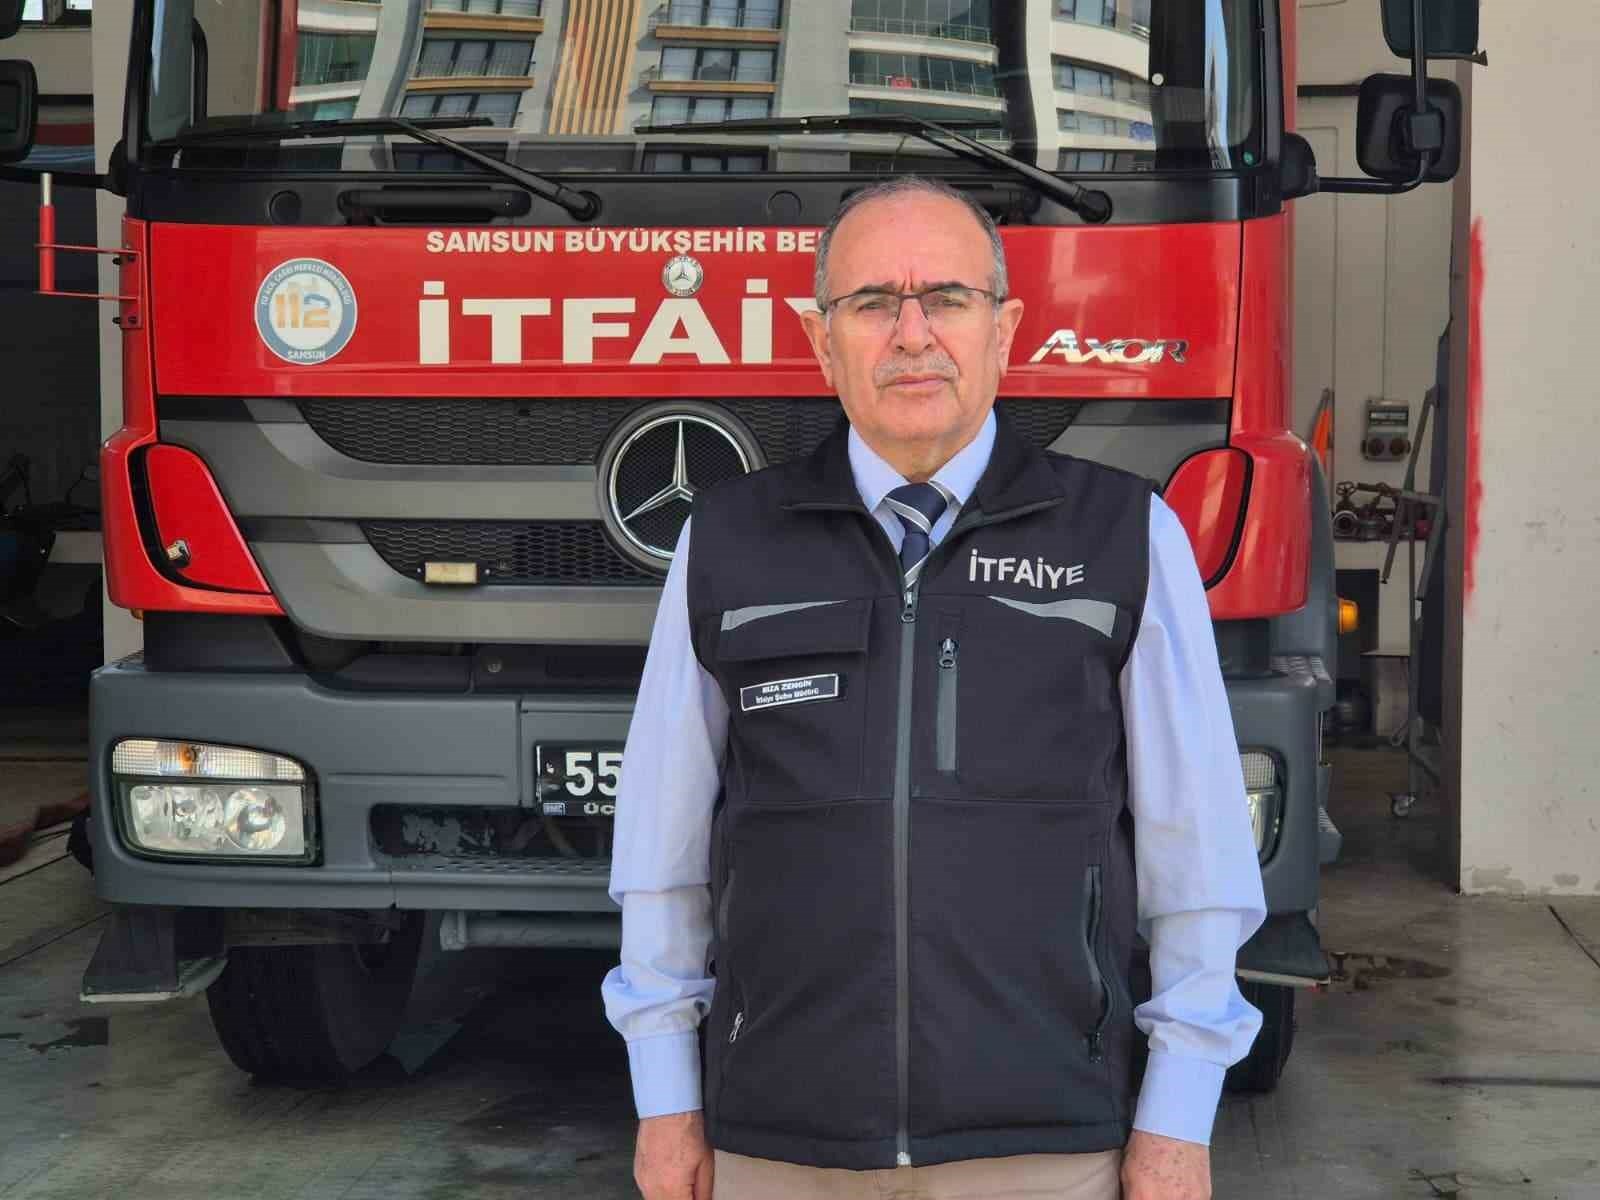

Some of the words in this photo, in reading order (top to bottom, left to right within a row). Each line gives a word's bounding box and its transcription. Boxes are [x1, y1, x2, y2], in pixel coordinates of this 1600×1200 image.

[426, 231, 554, 253] SAMSUN
[565, 227, 766, 254] BÜYÜKŞEHİR
[777, 231, 821, 253] BE
[275, 293, 331, 329] 112
[969, 548, 1085, 589] İTFAİYE
[566, 751, 623, 797] 55
